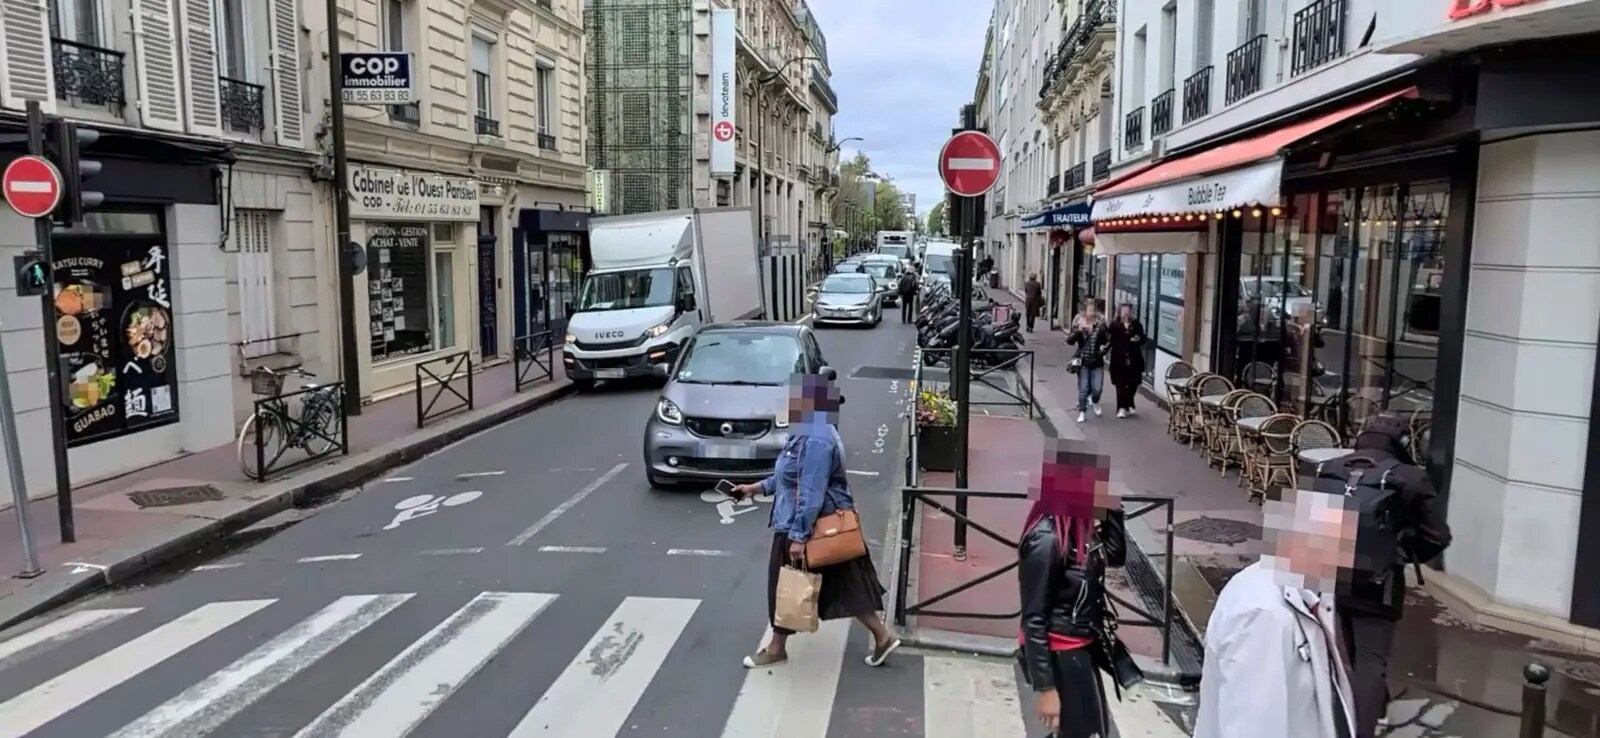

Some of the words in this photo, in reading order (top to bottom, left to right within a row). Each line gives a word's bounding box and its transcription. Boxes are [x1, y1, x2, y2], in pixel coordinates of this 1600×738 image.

[344, 75, 407, 86] immobilier
[343, 91, 354, 101] 01
[356, 91, 369, 101] 55
[370, 91, 381, 101] 63
[384, 91, 395, 101] 83
[398, 91, 409, 101] 83
[721, 72, 729, 118] devoteam
[352, 170, 394, 195] Cabinet
[397, 179, 409, 196] de
[412, 175, 444, 197] l'Ouest
[446, 180, 477, 200] Parisien
[1188, 184, 1212, 205] Bubble
[1213, 182, 1226, 202] Tea
[414, 202, 425, 215] 01
[427, 203, 438, 215] 55
[1052, 213, 1089, 223] TRAITEUR
[401, 226, 428, 237] GESTION
[371, 237, 394, 248] ACHAT
[399, 237, 418, 248] VENTE
[78, 257, 104, 269] CURRY
[595, 330, 624, 339] IVECO
[73, 404, 116, 433] GUABAO
